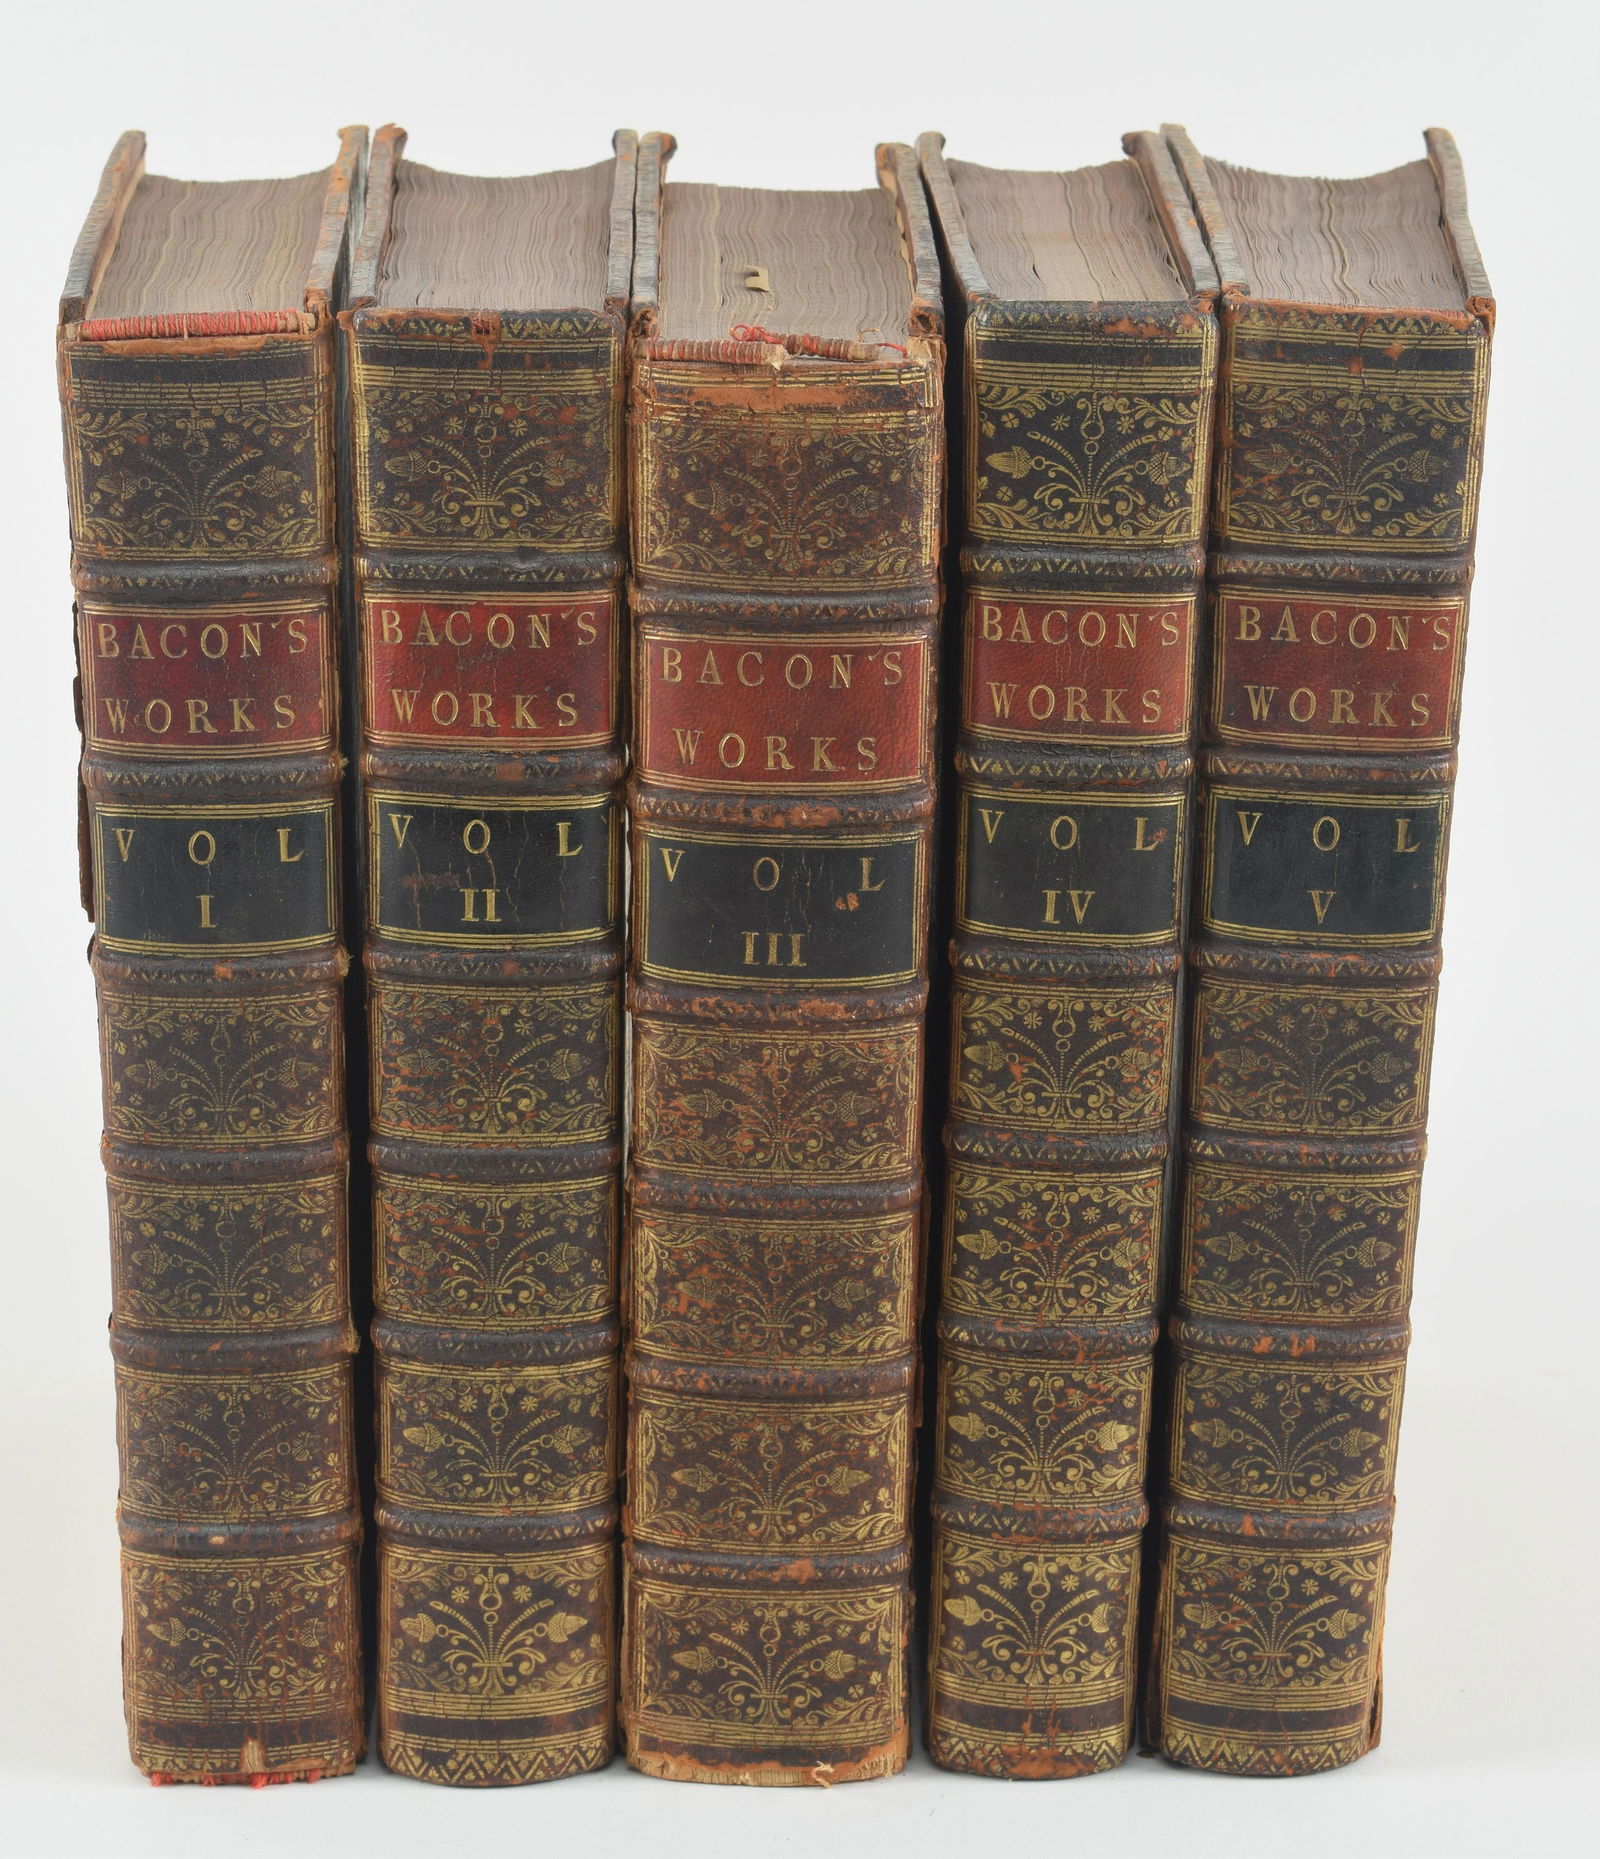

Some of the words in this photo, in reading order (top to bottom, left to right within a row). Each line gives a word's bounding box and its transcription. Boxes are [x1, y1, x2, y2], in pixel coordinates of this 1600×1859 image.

[98, 619, 308, 660] BACON'S
[381, 607, 598, 649] BACON'S
[978, 605, 1181, 650] BACON'S
[1234, 605, 1451, 651] BACON'S
[659, 646, 904, 690] BACON'S
[104, 694, 297, 734] WORKS
[391, 689, 579, 730] WORKS
[986, 682, 1164, 724] WORKS
[1243, 685, 1430, 727] WORKS
[672, 728, 879, 772] WORKS
[196, 894, 218, 929] I
[460, 888, 502, 923] II
[1041, 889, 1096, 925] IV
[1307, 889, 1337, 925] V
[741, 931, 807, 967] III
